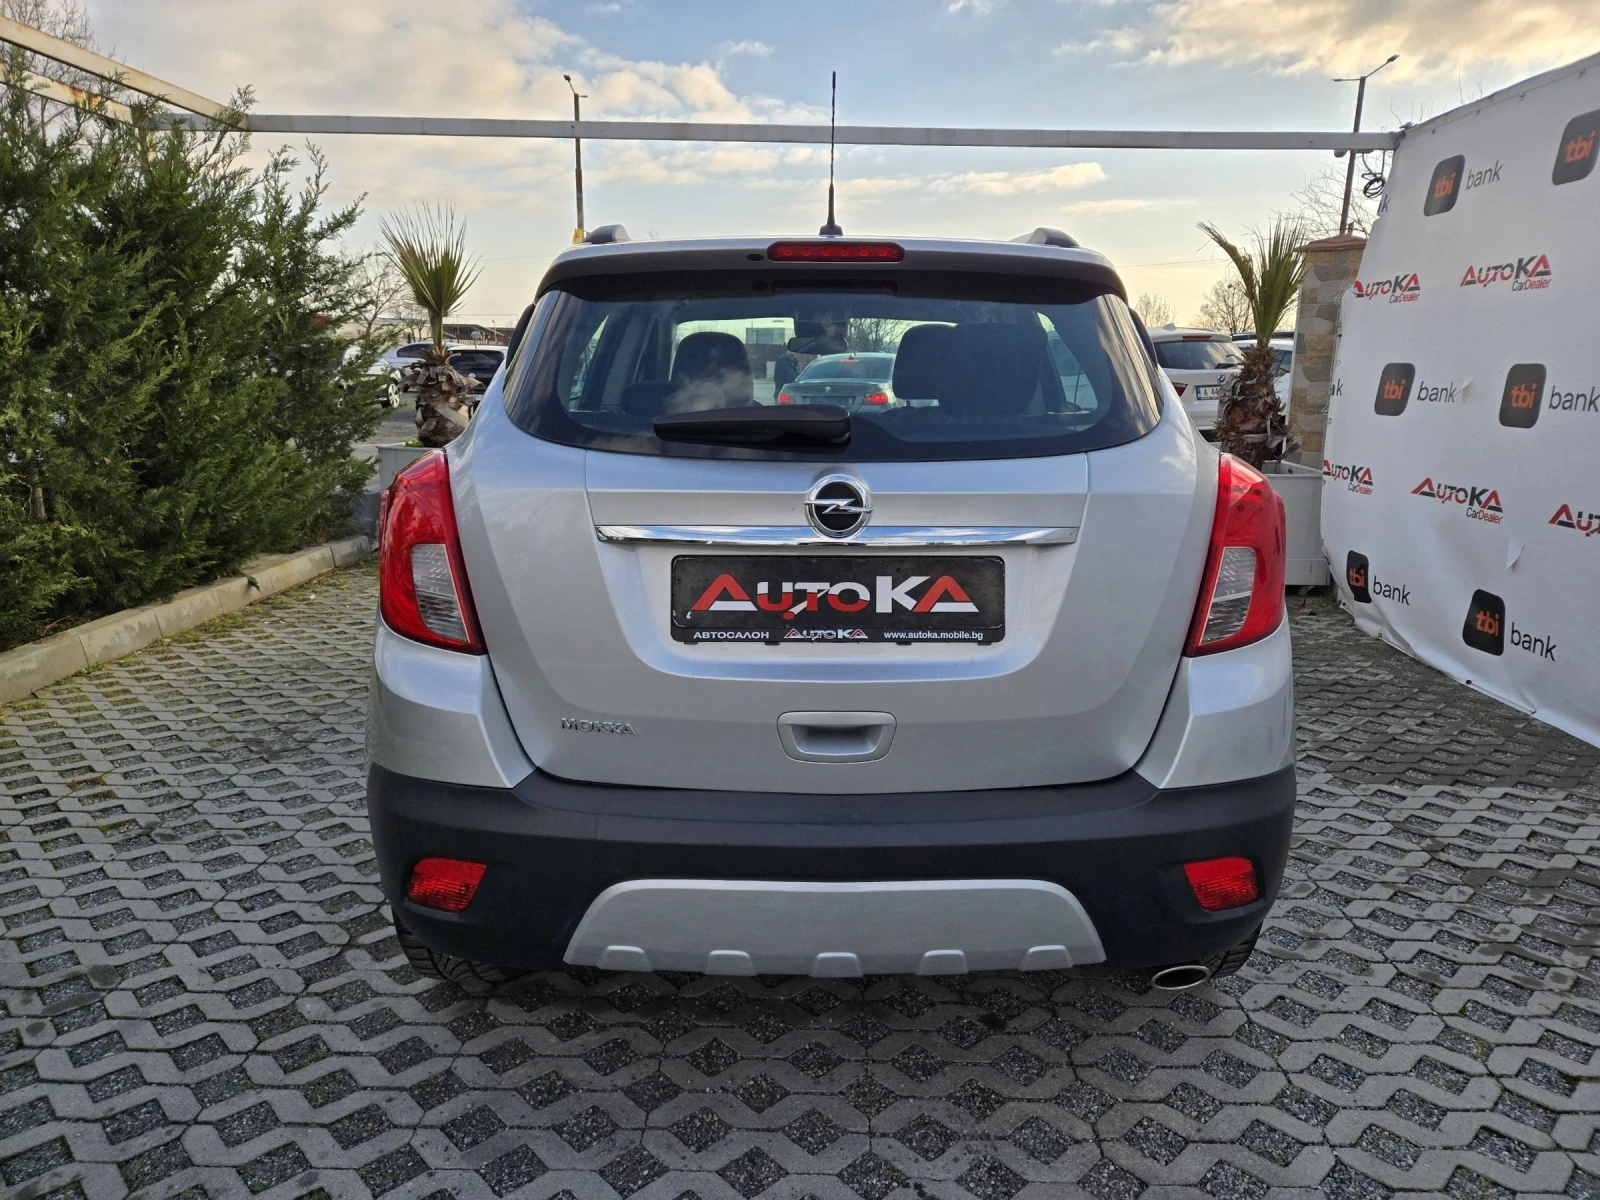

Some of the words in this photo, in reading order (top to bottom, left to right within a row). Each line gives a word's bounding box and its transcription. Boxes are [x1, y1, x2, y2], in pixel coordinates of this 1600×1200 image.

[1565, 130, 1597, 164] tbi
[1434, 172, 1456, 199] tbi
[1465, 160, 1504, 190] bank
[1511, 278, 1552, 292] CarDealer
[1389, 292, 1421, 304] CarDealer
[1383, 379, 1405, 400] tbi
[1416, 381, 1457, 403] bank
[1510, 383, 1536, 408] tbi
[1548, 385, 1600, 412] bank
[1465, 507, 1503, 525] CarDealer
[690, 573, 980, 621] AUTOKA
[1349, 568, 1365, 588] tbi
[1373, 575, 1411, 606] bank
[693, 630, 770, 640] АВТОСАЛОН
[883, 630, 984, 641] www.autoka.mobile.bg
[1475, 610, 1500, 637] tbi
[1511, 622, 1558, 661] bank
[561, 717, 638, 736] MOKKA
